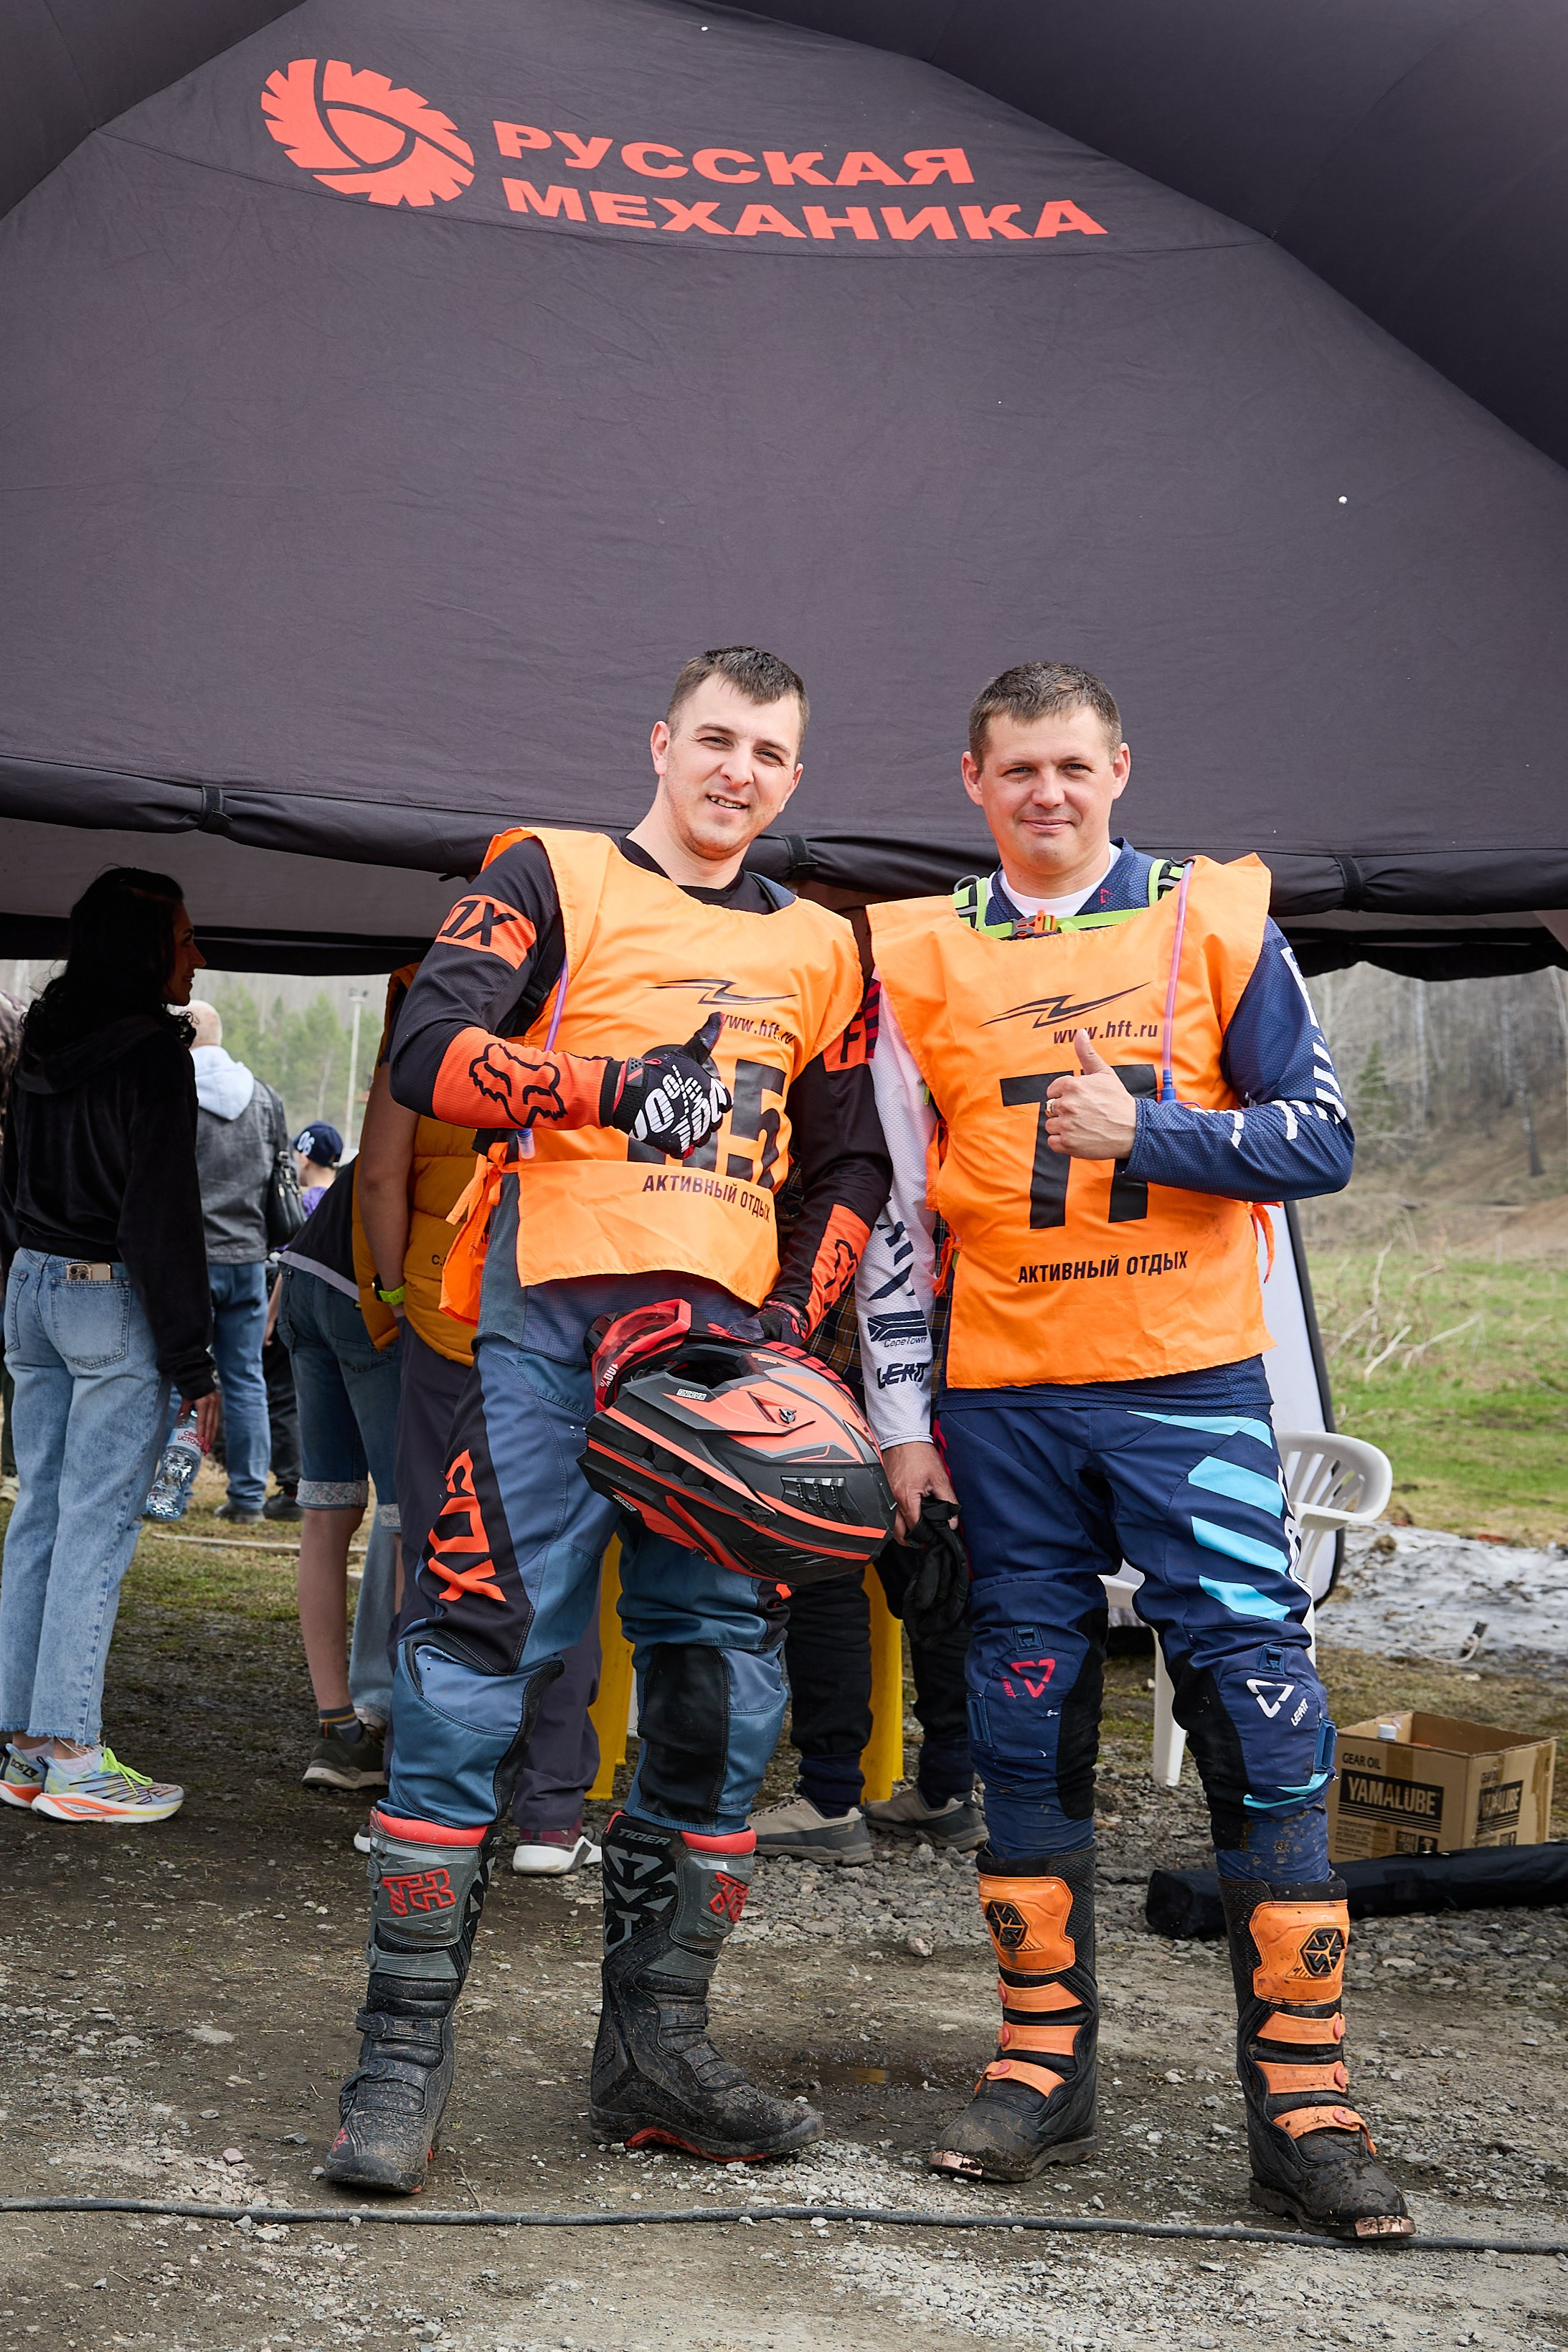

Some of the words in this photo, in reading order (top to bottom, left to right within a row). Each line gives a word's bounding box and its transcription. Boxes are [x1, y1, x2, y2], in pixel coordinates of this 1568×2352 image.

[493, 121, 974, 186] РУССКАЯ
[502, 178, 1107, 240] МЕХАНИКА
[642, 1174, 738, 1204] АКТИВНЫЙ
[740, 1191, 770, 1223] ОТДЫХ
[1018, 1254, 1120, 1283] АКТИВНЫЙ
[1126, 1250, 1189, 1276] ОТДЫХ
[676, 1389, 707, 1401] RACING
[1342, 1752, 1365, 1767] GEAR
[1367, 1757, 1382, 1770] OIL
[1348, 1775, 1437, 1815] YAMALUBE
[618, 1828, 671, 1846] TIGER
